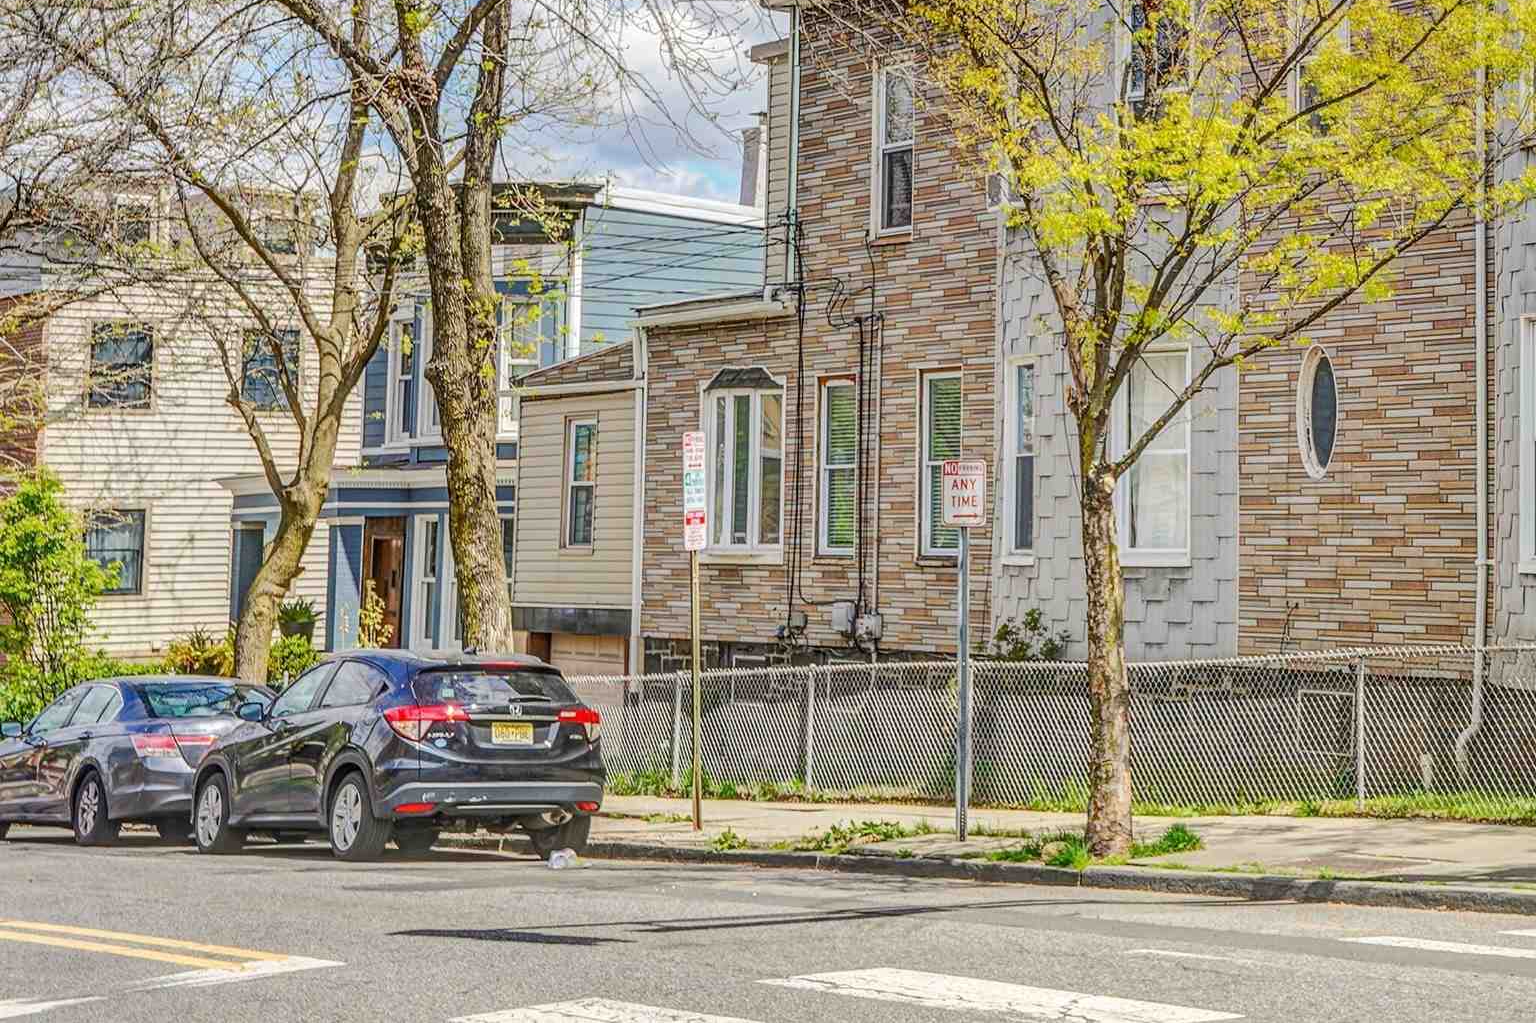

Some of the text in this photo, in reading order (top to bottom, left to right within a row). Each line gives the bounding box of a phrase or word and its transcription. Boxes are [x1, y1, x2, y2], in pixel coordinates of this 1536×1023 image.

[944, 462, 959, 474] NO
[952, 479, 977, 490] ANY
[952, 496, 977, 507] TIME
